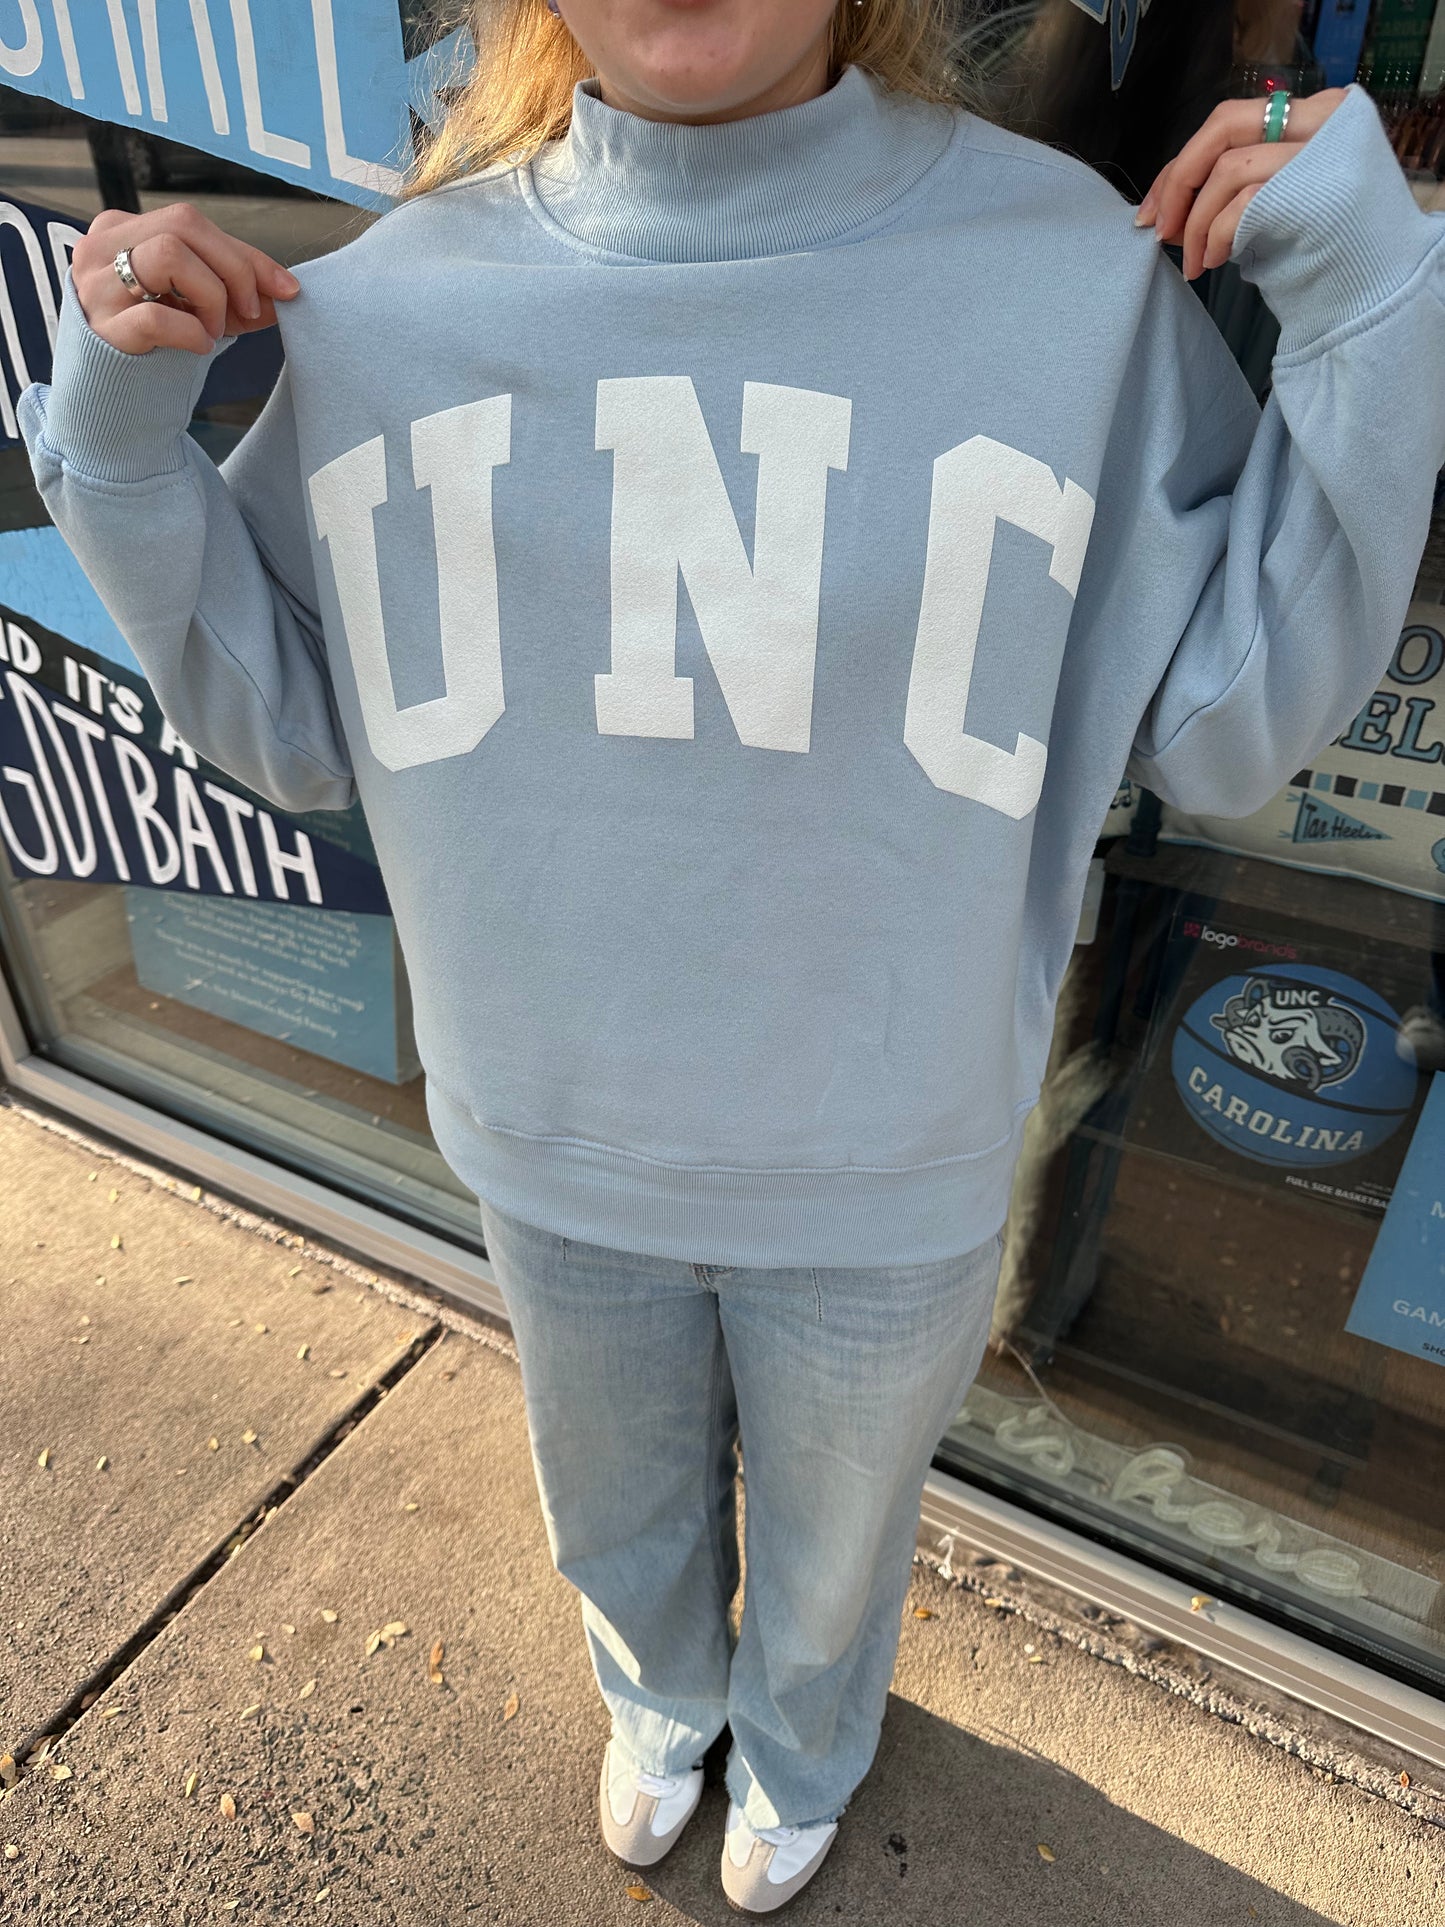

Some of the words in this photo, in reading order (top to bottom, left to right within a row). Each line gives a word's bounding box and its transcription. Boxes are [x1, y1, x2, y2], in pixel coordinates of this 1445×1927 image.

[308, 375, 1096, 820] UNC
[63, 655, 144, 734] IT'S
[1303, 802, 1329, 840] Tar
[1201, 925, 1297, 959] logobrands
[1275, 989, 1320, 1006] UNC
[1188, 1065, 1364, 1152] CAROLINA
[1285, 1175, 1309, 1189] FULL
[1311, 1181, 1334, 1195] SIZE
